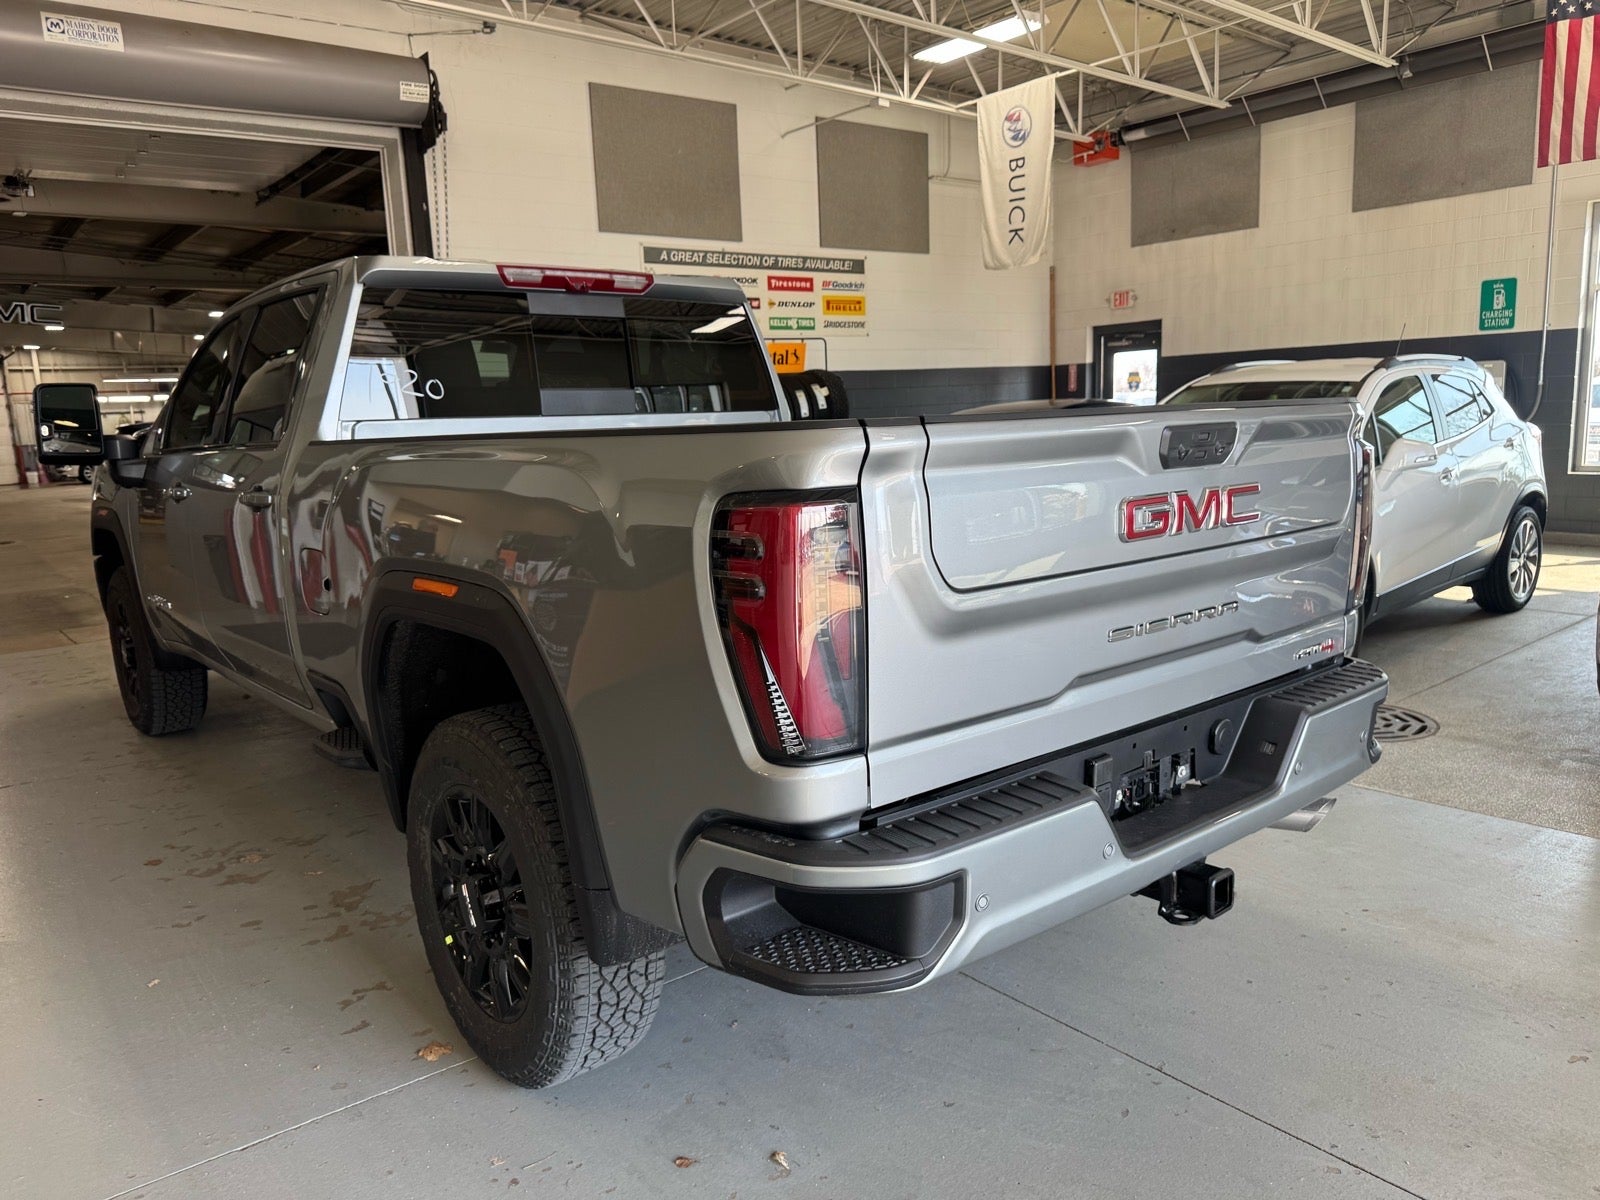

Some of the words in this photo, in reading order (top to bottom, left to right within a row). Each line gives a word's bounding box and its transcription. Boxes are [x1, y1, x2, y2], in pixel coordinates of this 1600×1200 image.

[66, 20, 95, 31] MAHON
[98, 25, 118, 35] DOOR
[67, 28, 120, 43] CORPORATION
[1008, 156, 1026, 245] BUICK
[660, 250, 668, 261] A
[670, 251, 703, 263] GREAT
[706, 252, 761, 266] SELECTION
[762, 256, 776, 266] OF
[777, 257, 803, 268] TIRES
[804, 259, 853, 271] AVAILABLE!
[770, 279, 811, 288] Firestone
[825, 300, 862, 312] PIRELLI
[1113, 290, 1129, 307] EXIT
[0, 302, 63, 325] MC
[1481, 309, 1513, 319] CHARGING
[824, 320, 865, 329] BRIDGESTONE
[1484, 318, 1510, 328] STATION
[771, 349, 789, 366] tal
[1119, 482, 1260, 543] GMC
[1107, 600, 1239, 643] SIERRA
